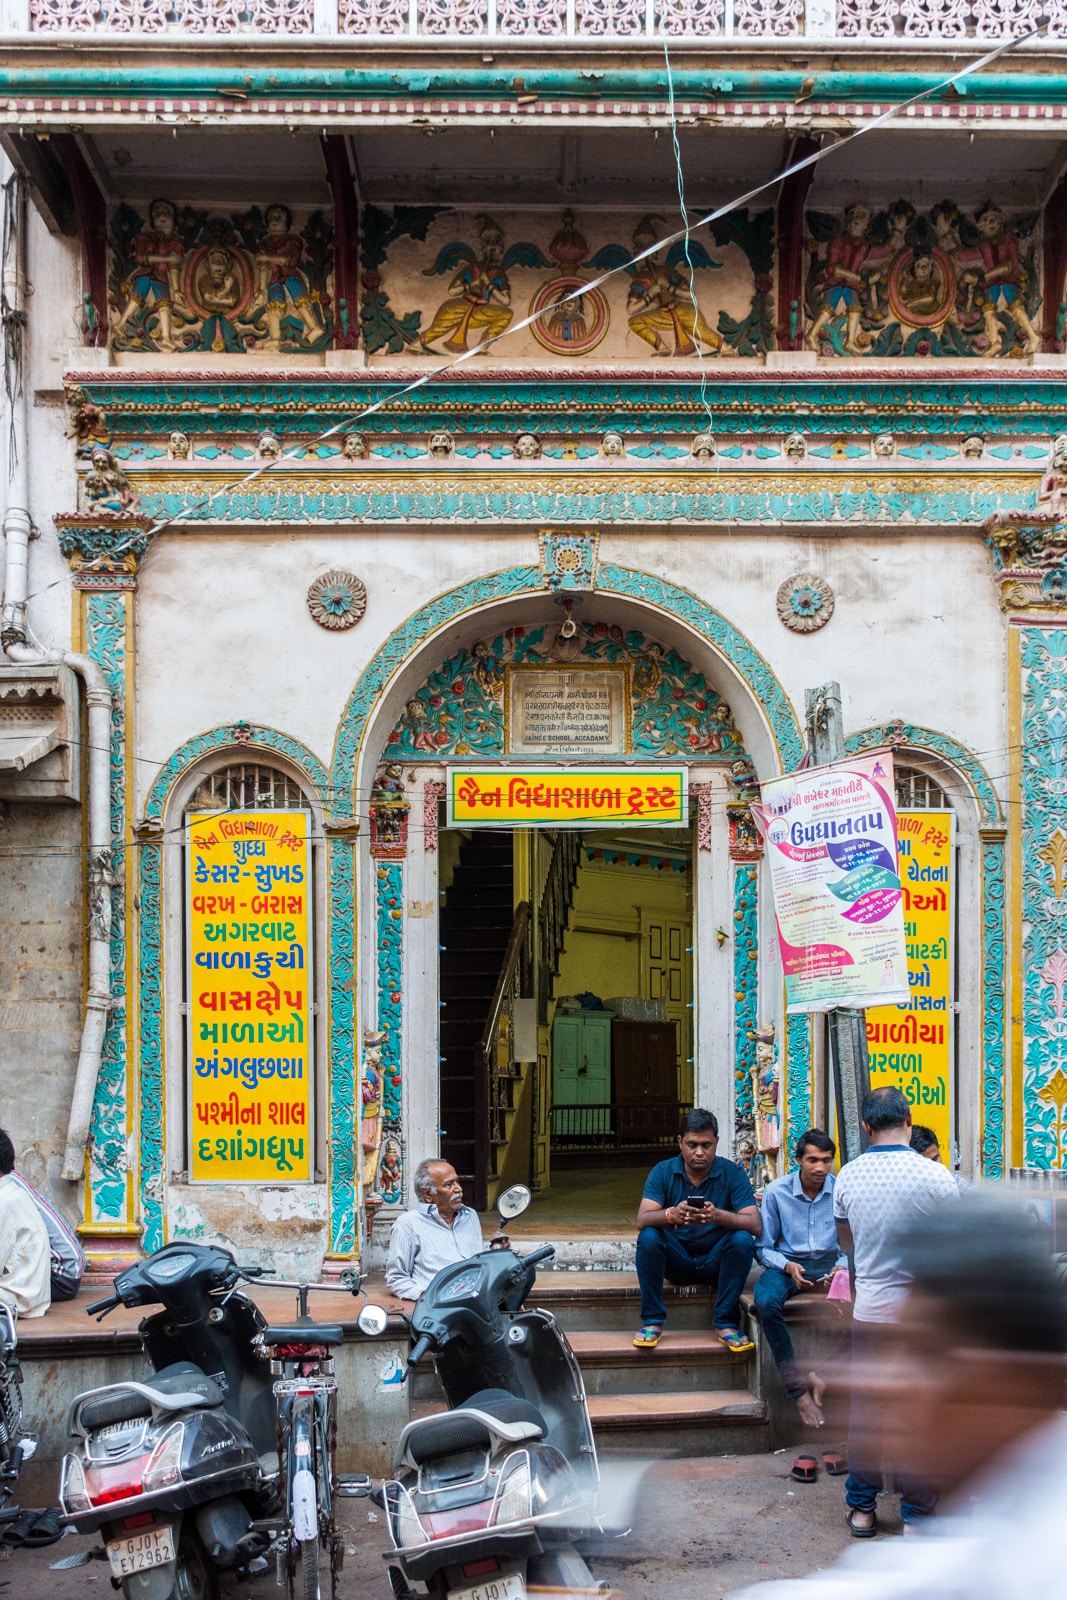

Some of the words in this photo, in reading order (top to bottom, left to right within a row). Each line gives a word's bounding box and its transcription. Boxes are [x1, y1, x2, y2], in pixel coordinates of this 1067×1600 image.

[458, 777, 501, 808] જૈન
[627, 786, 676, 816] ટ્રસ્ટ
[791, 793, 802, 807] શ્રી
[193, 832, 219, 851] જૈન
[276, 830, 304, 852] ટ્રસ્ટ
[920, 826, 949, 849] ટ્રસ્ટ
[198, 981, 303, 1016] વાસક્ષેપ
[199, 1013, 304, 1044] માળાઓ
[268, 1101, 305, 1126] શાલ
[122, 1417, 145, 1431] AUTO
[120, 1545, 171, 1574] EY2962
